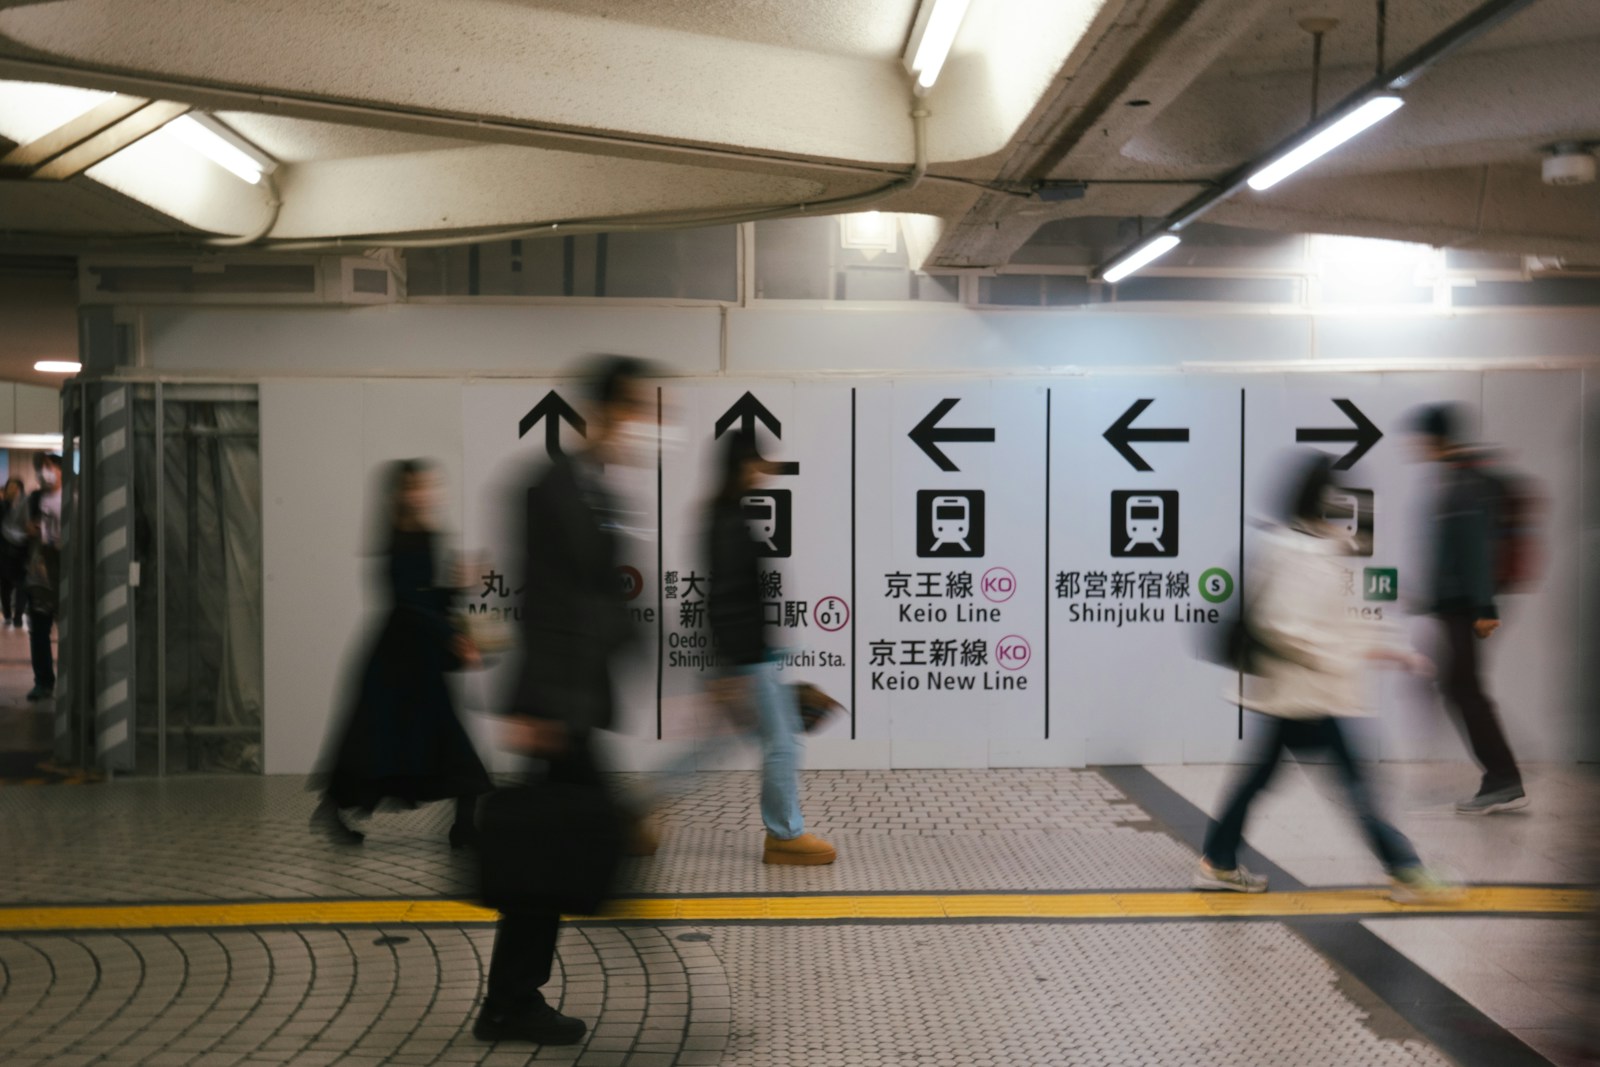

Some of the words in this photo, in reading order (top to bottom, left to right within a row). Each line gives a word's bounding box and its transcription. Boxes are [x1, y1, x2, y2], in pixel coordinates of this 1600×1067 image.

[664, 571, 678, 599] 都営
[681, 571, 783, 599] 大線
[884, 571, 974, 599] 京王線
[984, 577, 1012, 592] KO
[1055, 571, 1190, 599] 都営新宿線
[1211, 579, 1220, 592] S
[1368, 576, 1391, 593] JR
[680, 600, 808, 628] 新口駅
[828, 600, 835, 610] E
[899, 603, 947, 622] Keio
[956, 603, 1001, 622] Line
[1069, 603, 1164, 627] Shinjuku
[1174, 603, 1219, 623] Line
[820, 612, 841, 625] 01
[669, 632, 707, 648] Oedo
[818, 651, 846, 667] Sta.
[869, 639, 988, 667] 京王新線
[999, 645, 1027, 660] KO
[872, 671, 920, 690] Keio
[927, 671, 976, 690] New
[983, 671, 1028, 690] Line
